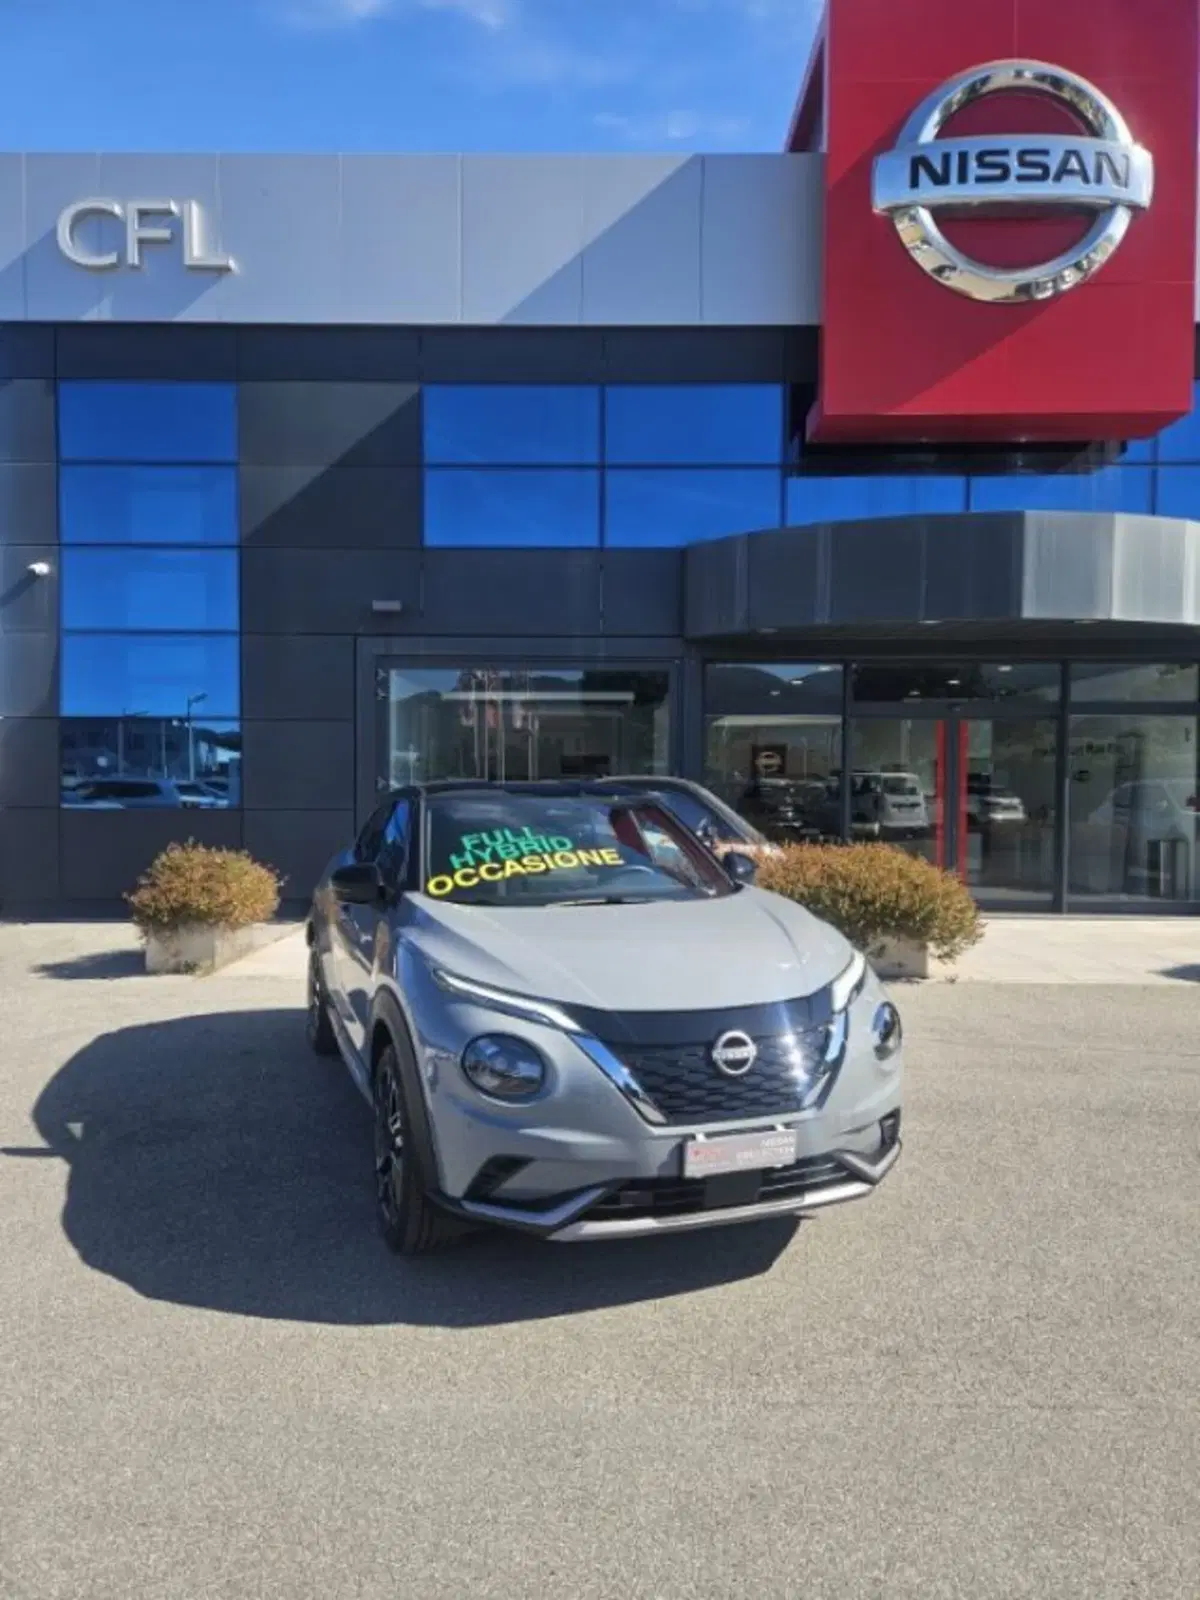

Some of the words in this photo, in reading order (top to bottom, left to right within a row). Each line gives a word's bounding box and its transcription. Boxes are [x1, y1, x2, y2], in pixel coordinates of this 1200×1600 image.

[909, 148, 1131, 190] NISSAN
[56, 197, 239, 273] CFL
[449, 835, 573, 869] HYBRID
[461, 826, 536, 851] FULL
[427, 848, 625, 896] OCCASIONE
